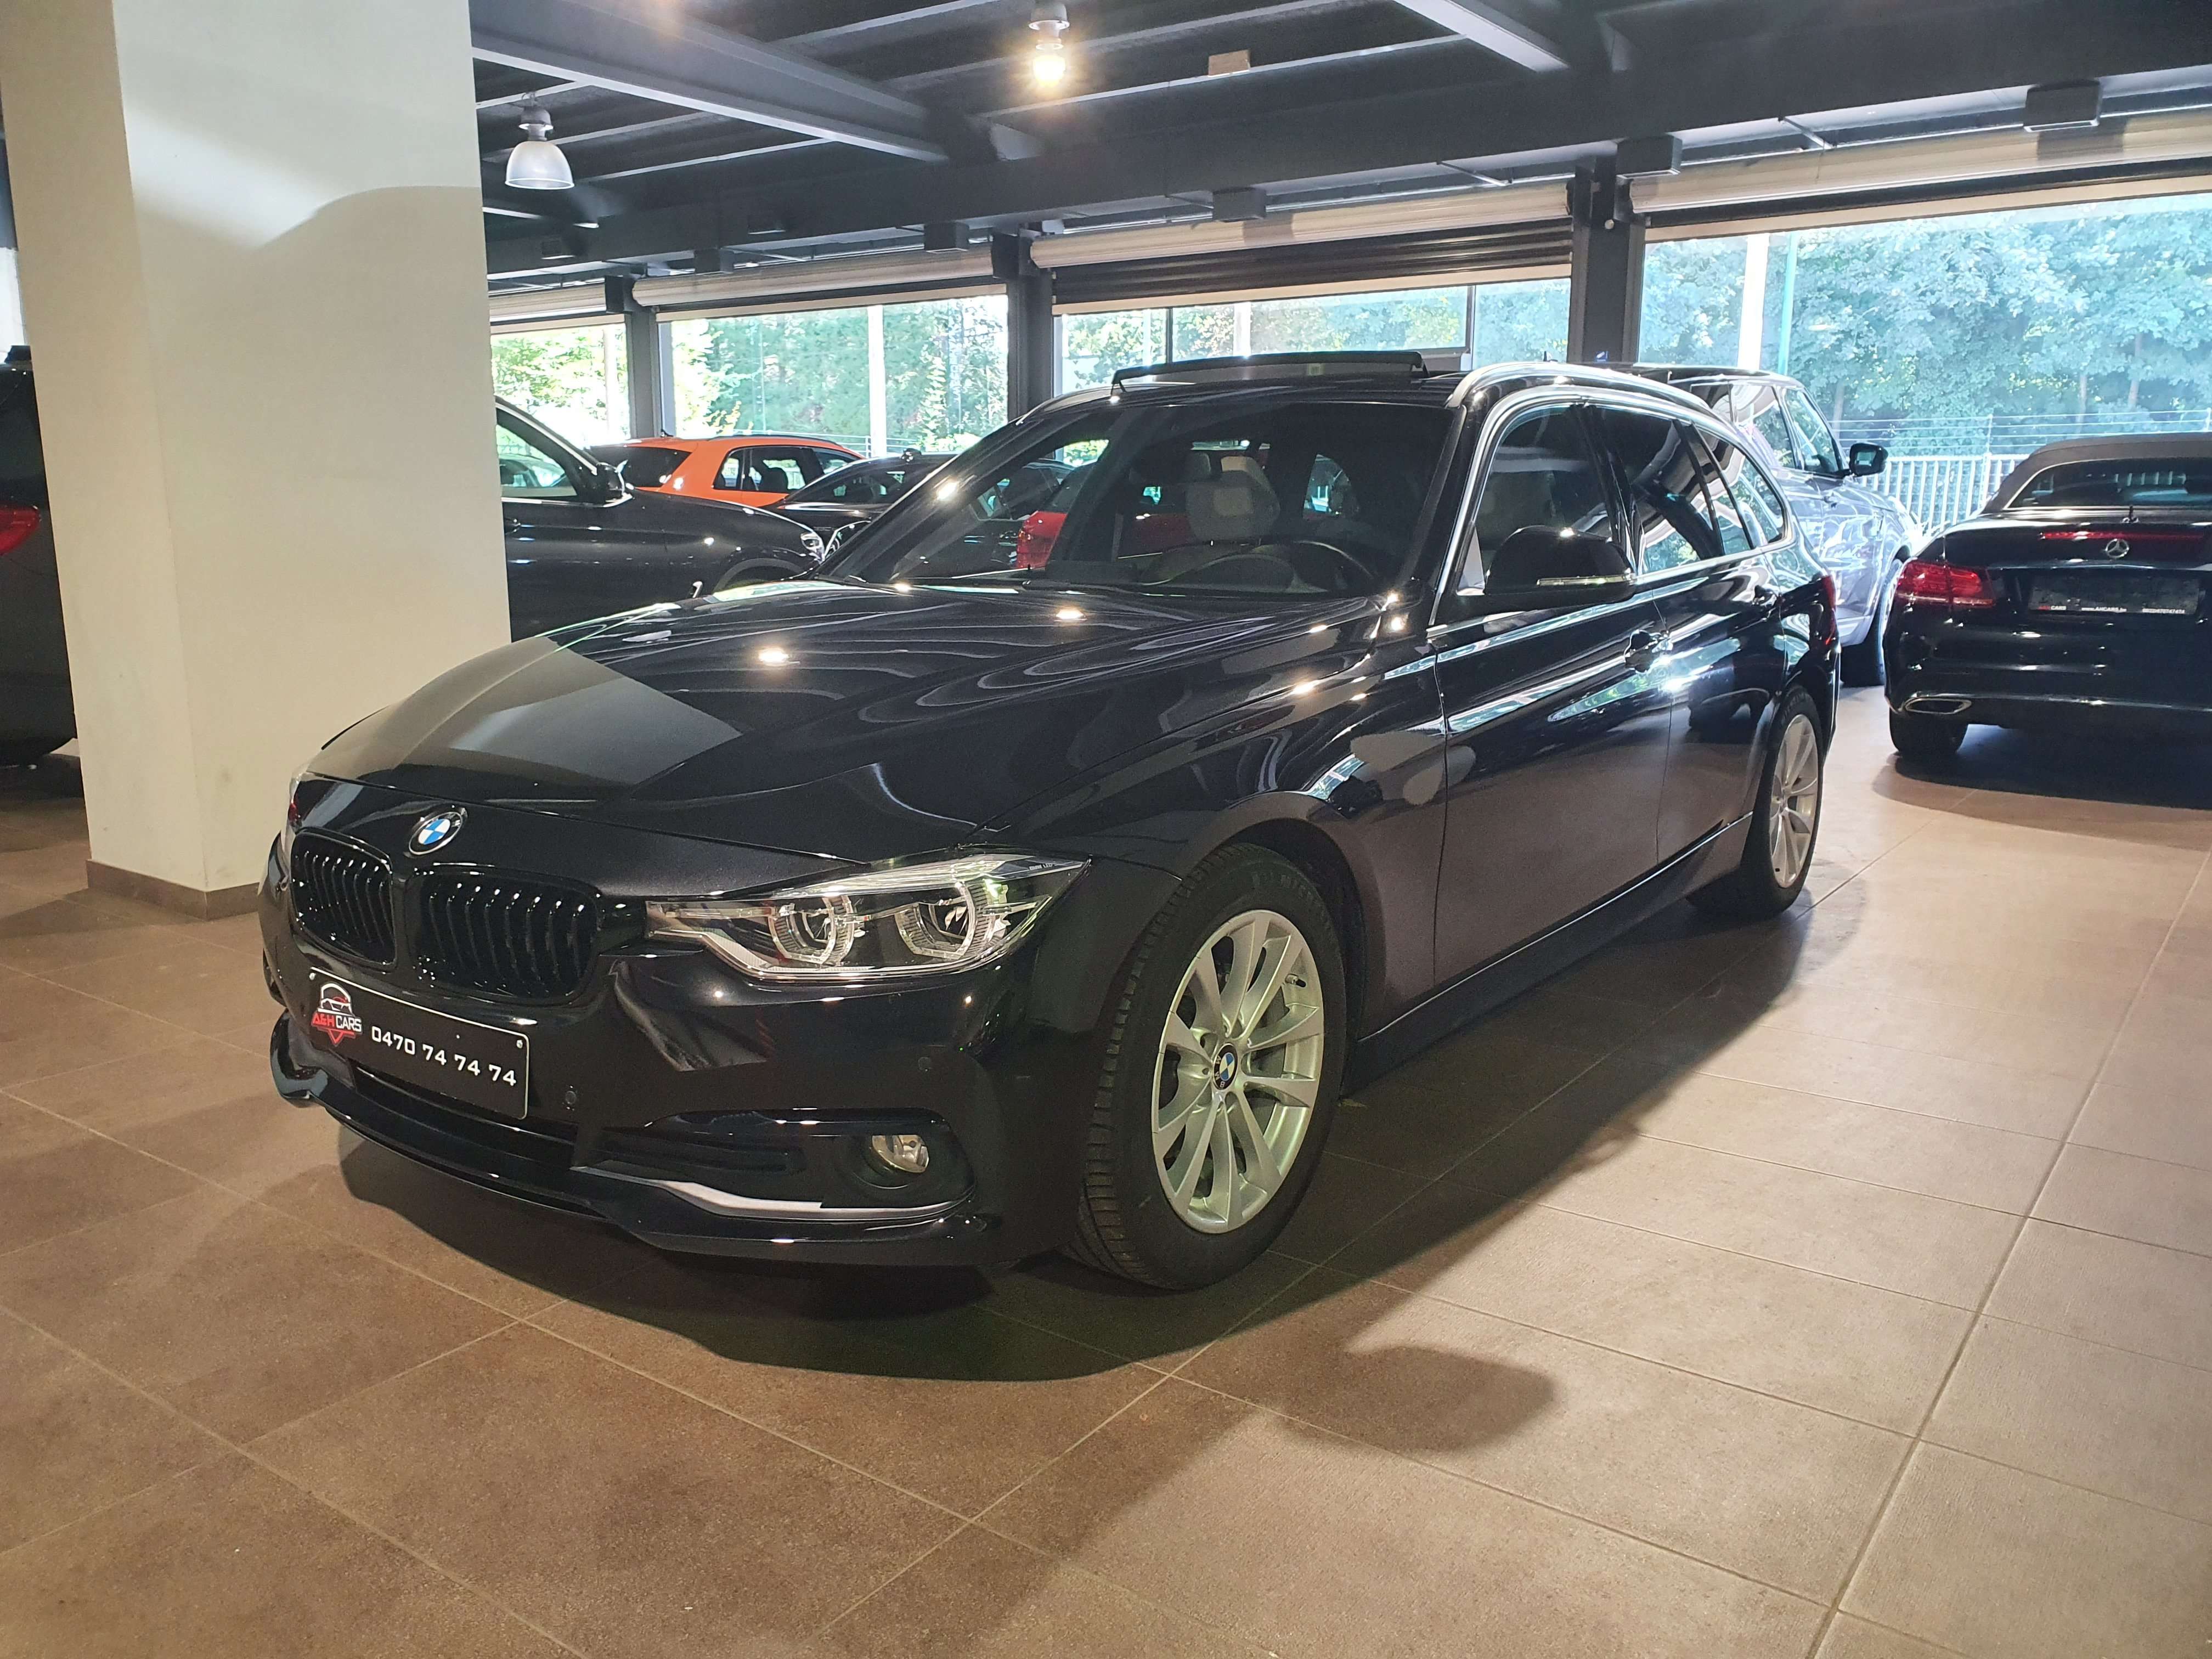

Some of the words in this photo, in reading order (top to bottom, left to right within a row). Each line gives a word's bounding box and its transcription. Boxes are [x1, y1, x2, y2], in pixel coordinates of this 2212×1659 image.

[313, 1013, 335, 1028] A&H
[336, 1015, 362, 1032] CARS
[372, 1026, 415, 1055] 0470
[422, 1044, 447, 1065] 74
[455, 1054, 481, 1076] 74
[489, 1064, 516, 1086] 74
